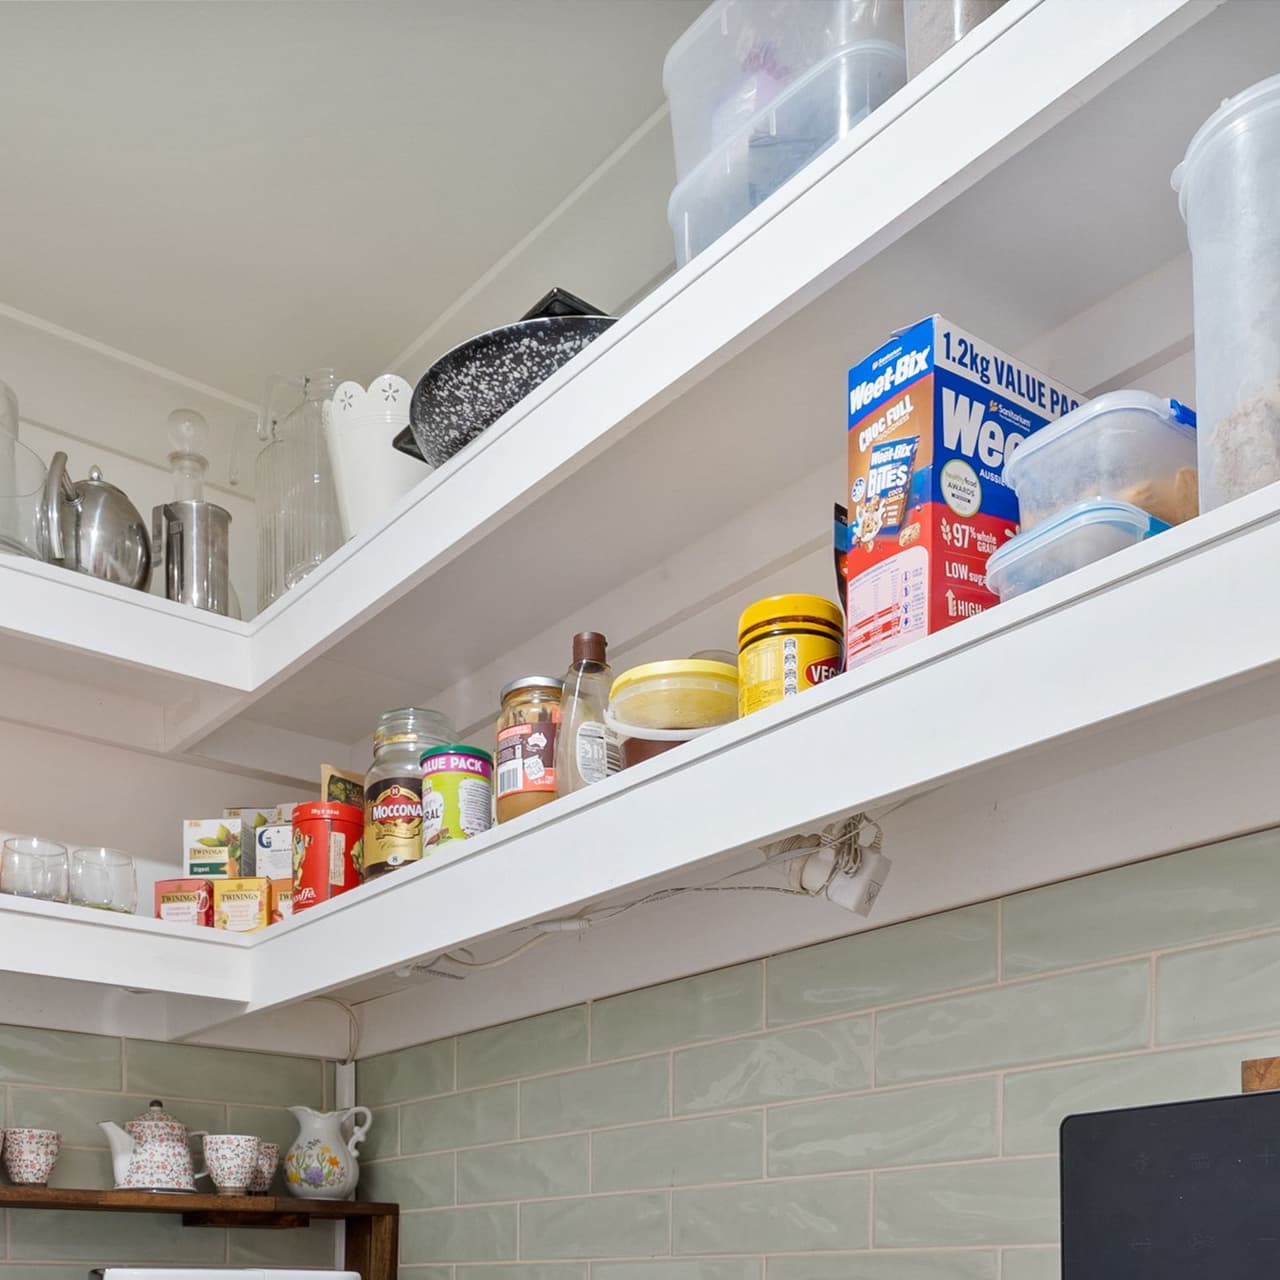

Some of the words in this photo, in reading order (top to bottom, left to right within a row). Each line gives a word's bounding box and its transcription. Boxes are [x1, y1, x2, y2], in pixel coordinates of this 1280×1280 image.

[944, 332, 990, 384] 1.2kg
[994, 356, 1046, 408] VALUE
[850, 345, 931, 414] Weet-Bix
[859, 418, 885, 452] CHOC
[886, 394, 913, 426] FULL
[998, 405, 1031, 428] Sanitarium
[871, 443, 913, 467] Weet-Bix
[976, 530, 997, 545] whole
[945, 561, 969, 580] LOW
[422, 757, 446, 773] ALUE
[450, 757, 482, 773] PACK
[373, 804, 423, 820] MOCCONA
[192, 848, 223, 856] TWININGS
[161, 894, 198, 904] TWININGS
[221, 893, 259, 901] TWININGS
